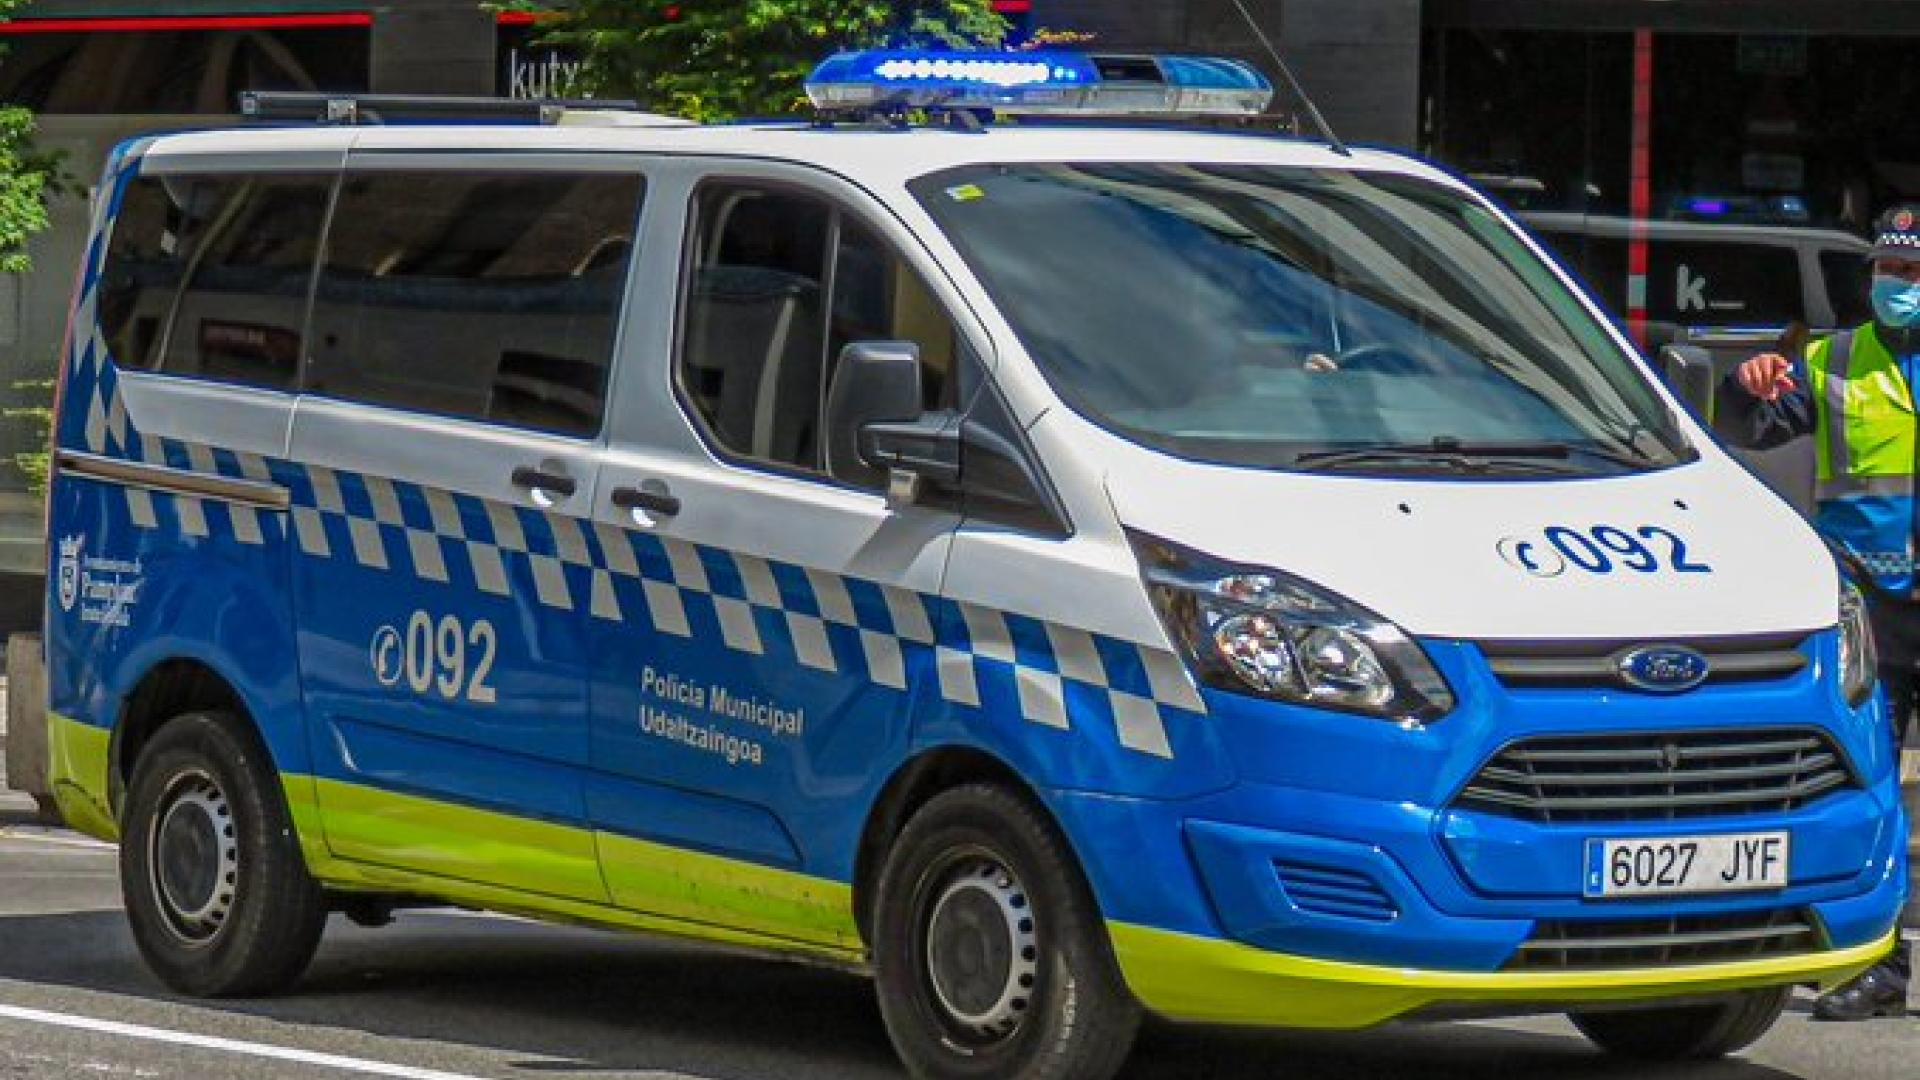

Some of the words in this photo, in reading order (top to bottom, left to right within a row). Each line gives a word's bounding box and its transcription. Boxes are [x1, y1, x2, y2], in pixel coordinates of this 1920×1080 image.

[1544, 526, 1712, 573] 092
[406, 609, 497, 703] 092
[640, 704, 763, 765] Udaltzaingoa
[710, 685, 804, 736] Municipal
[1611, 843, 1697, 887] 6027
[1721, 837, 1781, 883] JYF
